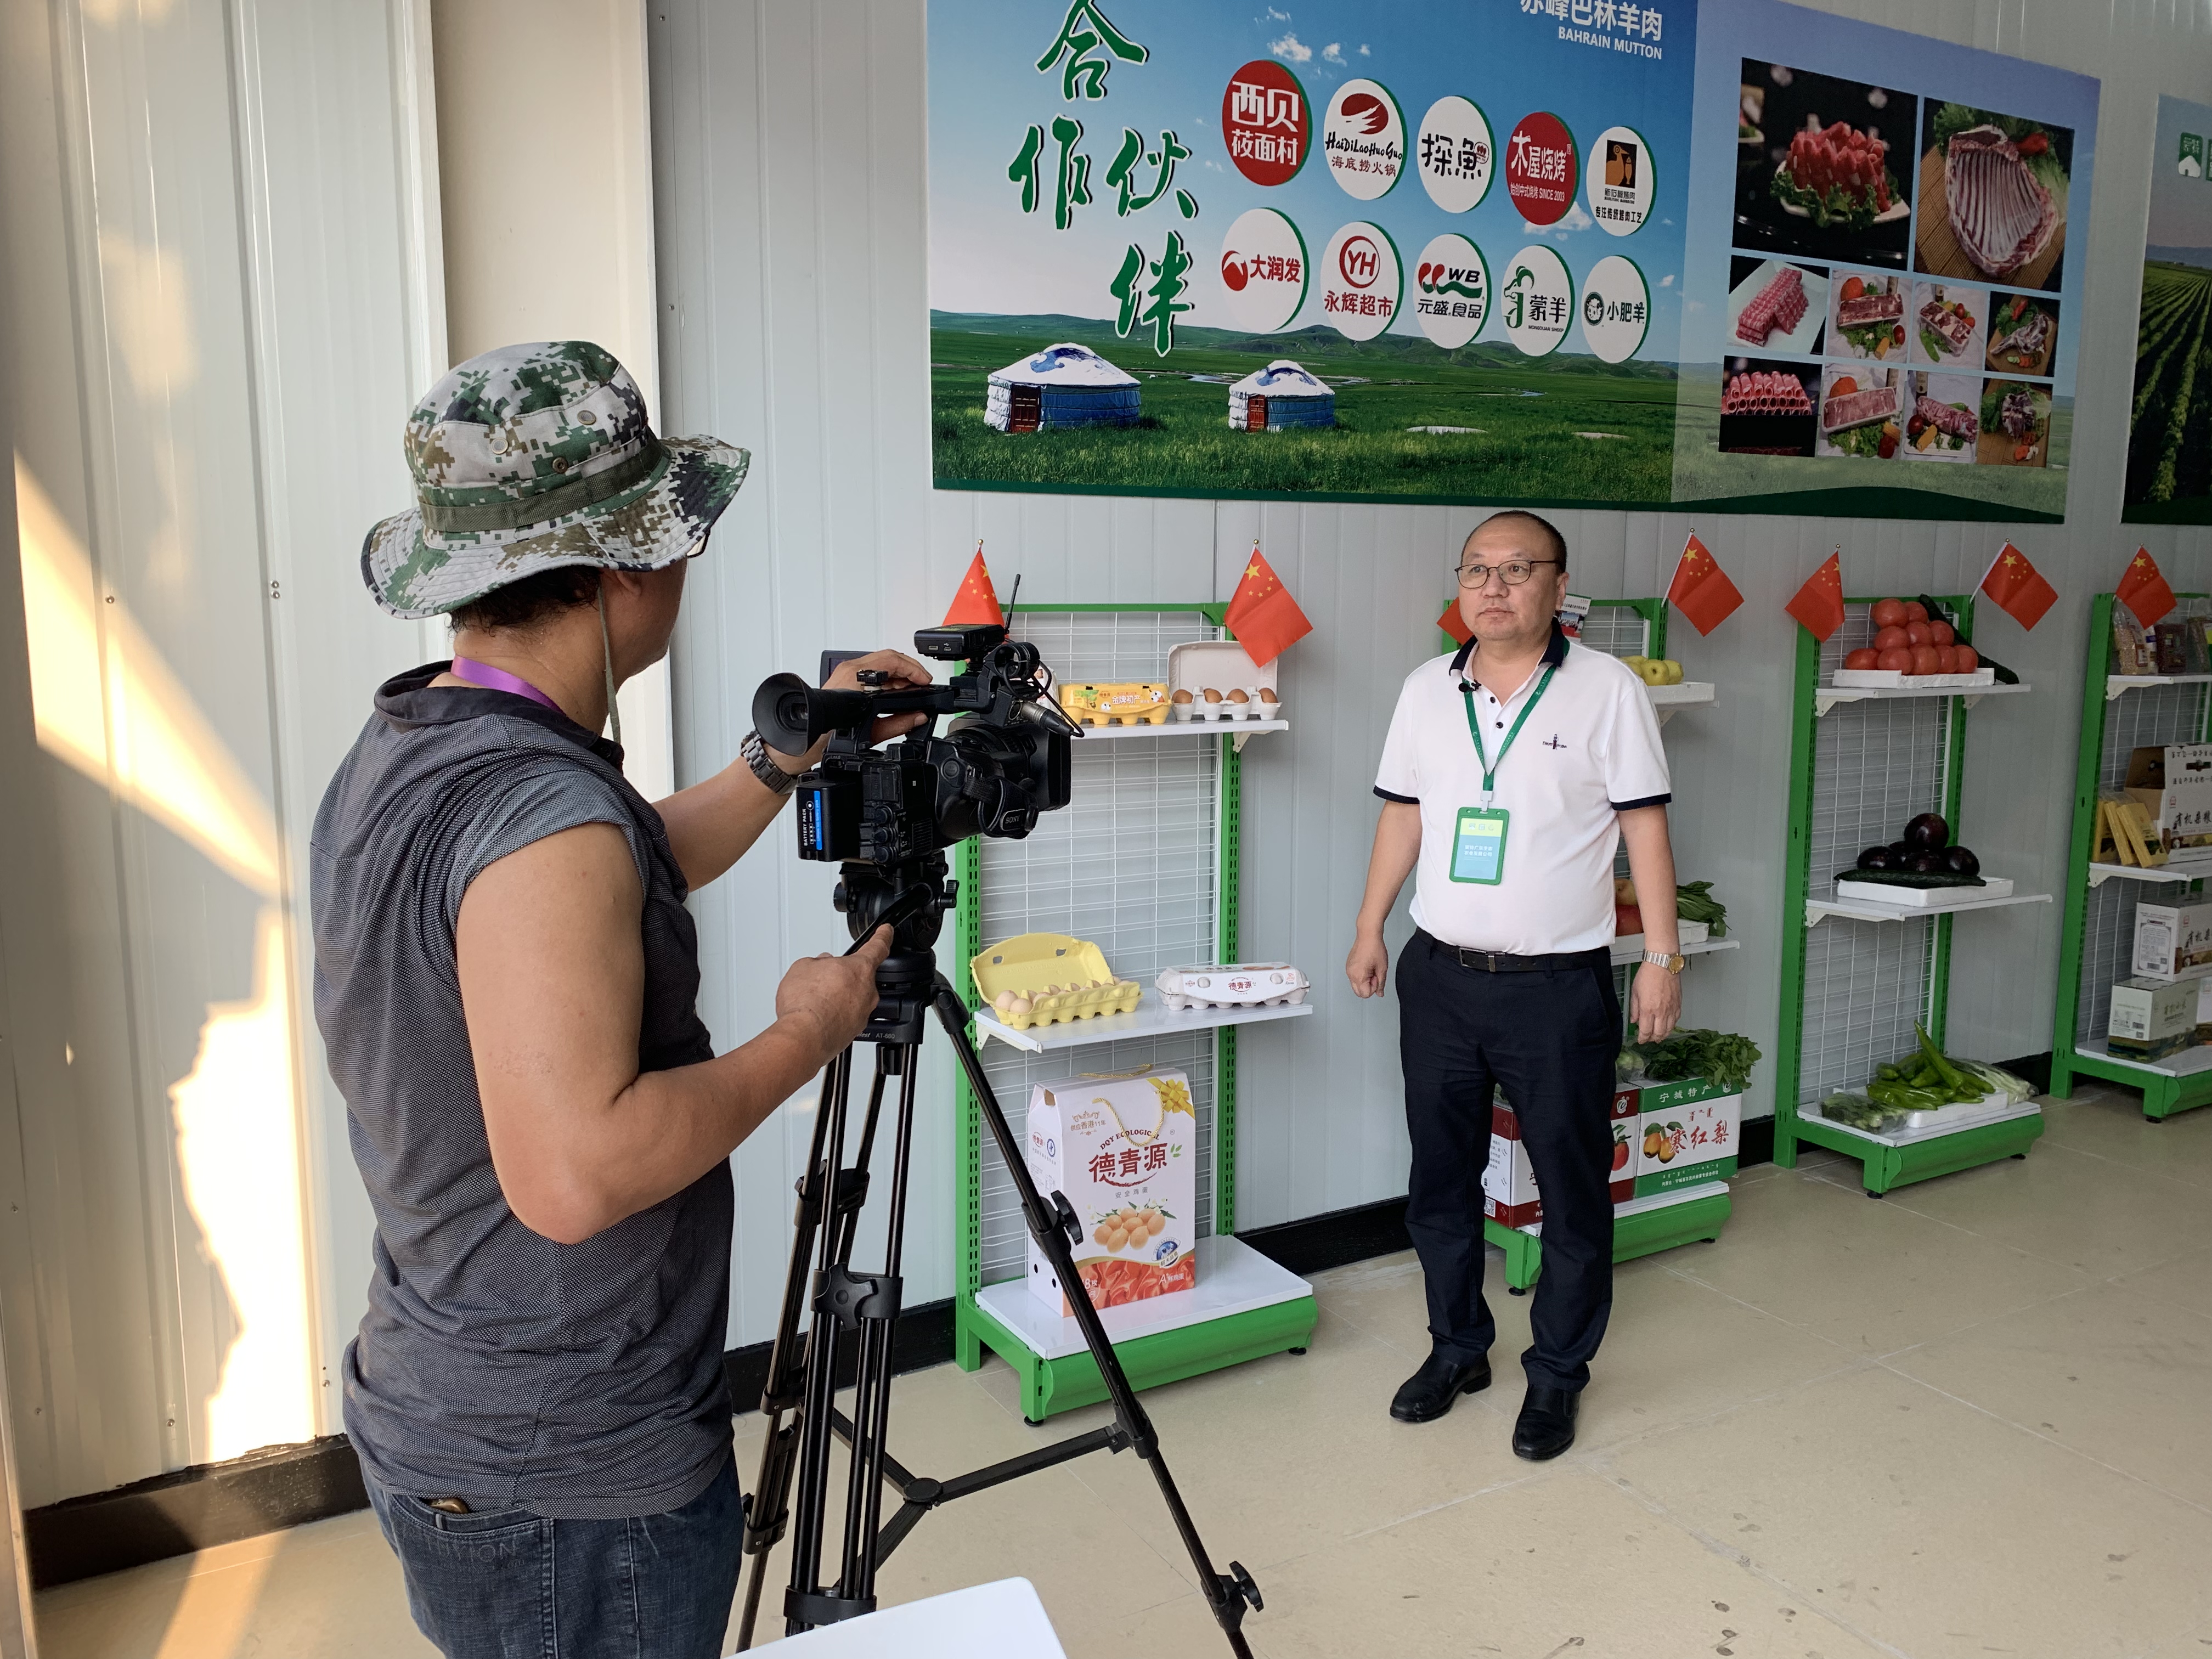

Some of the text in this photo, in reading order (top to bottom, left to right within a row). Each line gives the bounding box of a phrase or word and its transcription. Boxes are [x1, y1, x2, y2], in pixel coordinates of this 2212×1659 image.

[1558, 26, 1662, 60] BAHRAIN MUTTON
[1232, 81, 1300, 132] 西贝
[1231, 128, 1299, 166] 莜面村
[1325, 131, 1403, 160] HaiDiLaoHuoGuo
[1421, 133, 1482, 180] 探鱼
[1511, 130, 1567, 183] 木屋烧烤
[1331, 155, 1396, 177] 海底捞火锅
[1539, 187, 1554, 201] SINCE
[1554, 191, 1565, 202] 2003
[1595, 206, 1642, 223] 专注传统烤肉工艺
[1250, 253, 1301, 283] 大润发
[1347, 250, 1376, 276] YH
[1448, 267, 1480, 283] WB
[1324, 290, 1393, 317] 永辉超市
[1417, 298, 1482, 319] 元盛食品
[1528, 295, 1566, 324] 蒙羊
[1607, 301, 1645, 324] 小肥羊
[1112, 695, 1141, 704] 金牌初产
[1005, 815, 1020, 824] SONY
[1659, 1084, 1711, 1103] 宁城特产
[1070, 1120, 1107, 1131] 供应香港11年
[1669, 1119, 1729, 1154] 寒红梨
[1100, 1136, 1115, 1150] DQY
[1088, 1143, 1168, 1183] 德青源
[1115, 1186, 1148, 1199] 安全鸡蛋
